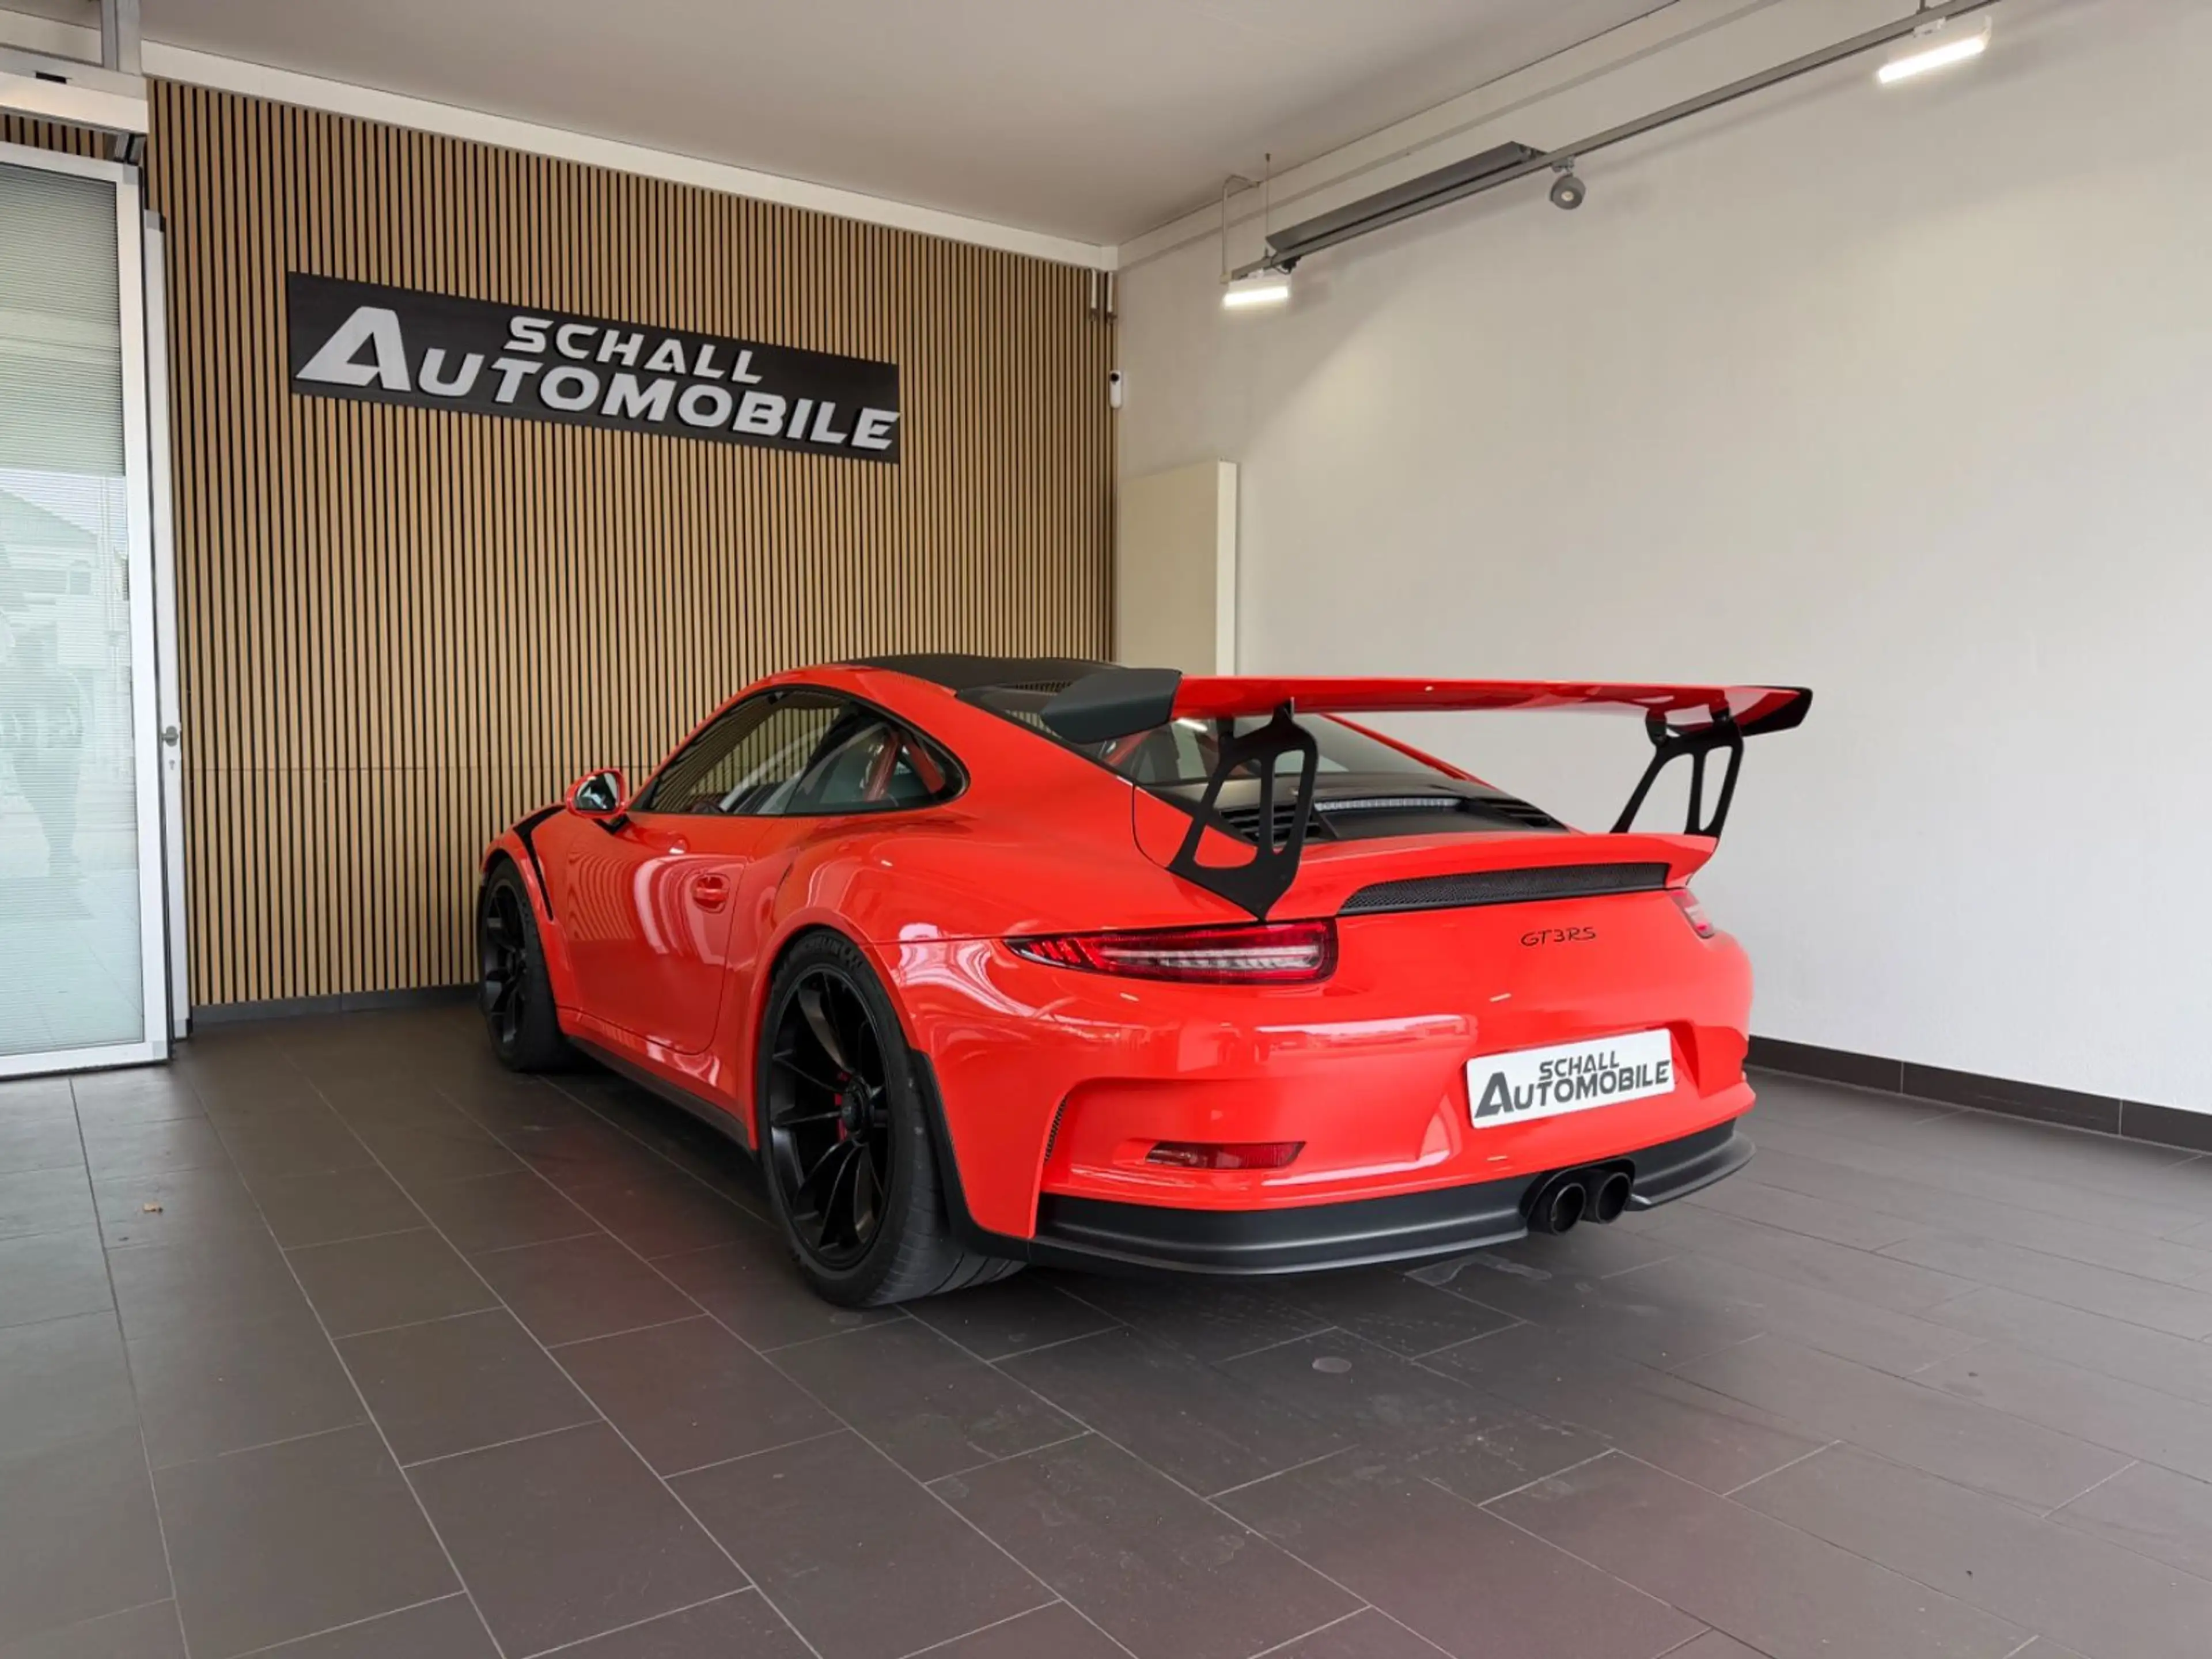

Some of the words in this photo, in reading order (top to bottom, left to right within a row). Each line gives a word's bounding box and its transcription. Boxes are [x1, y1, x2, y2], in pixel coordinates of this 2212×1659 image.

[294, 306, 900, 450] AUTOMOBILE
[505, 316, 762, 384] SCHALL
[1474, 1060, 1670, 1118] AUTOMOBILE
[1539, 1050, 1620, 1081] SCHALL
